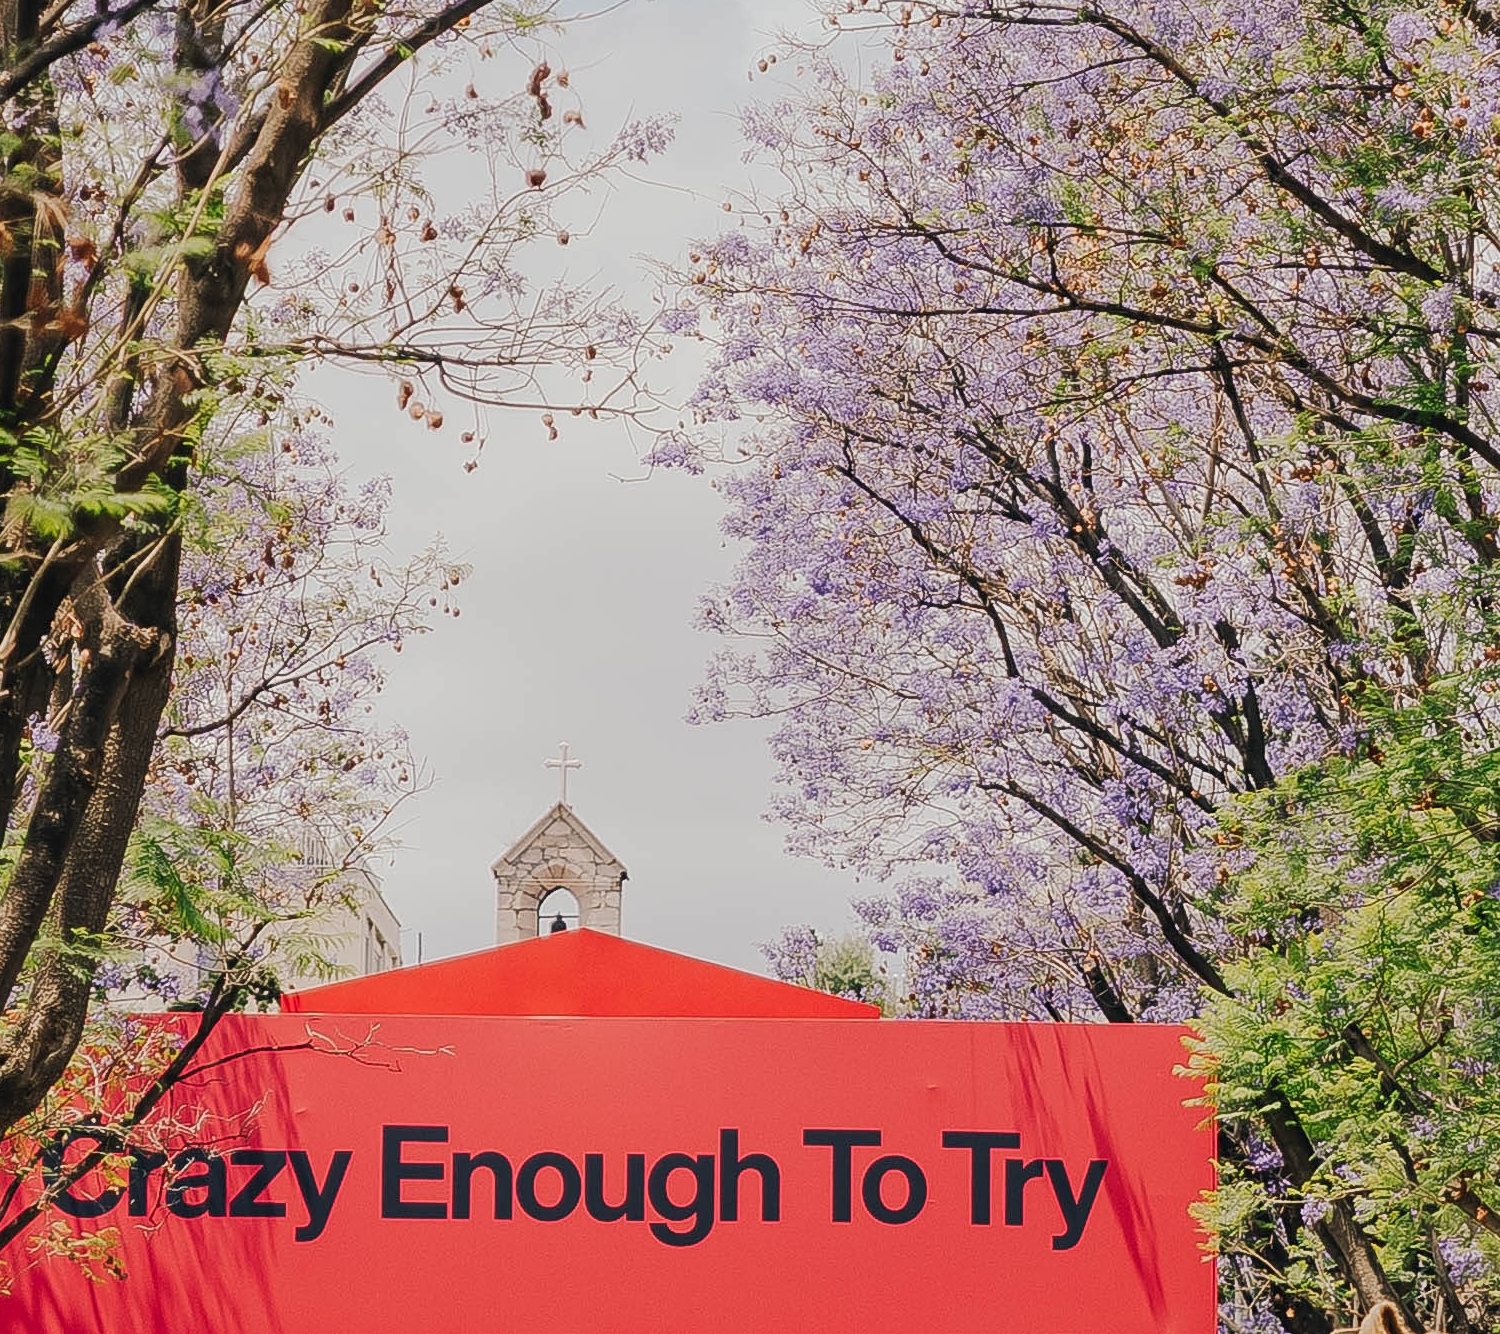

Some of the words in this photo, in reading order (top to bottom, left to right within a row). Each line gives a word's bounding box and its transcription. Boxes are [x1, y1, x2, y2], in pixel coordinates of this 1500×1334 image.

[42, 1124, 354, 1243] Crazy
[381, 1124, 781, 1248] Enough
[802, 1128, 928, 1225] To
[942, 1130, 1109, 1251] Try
